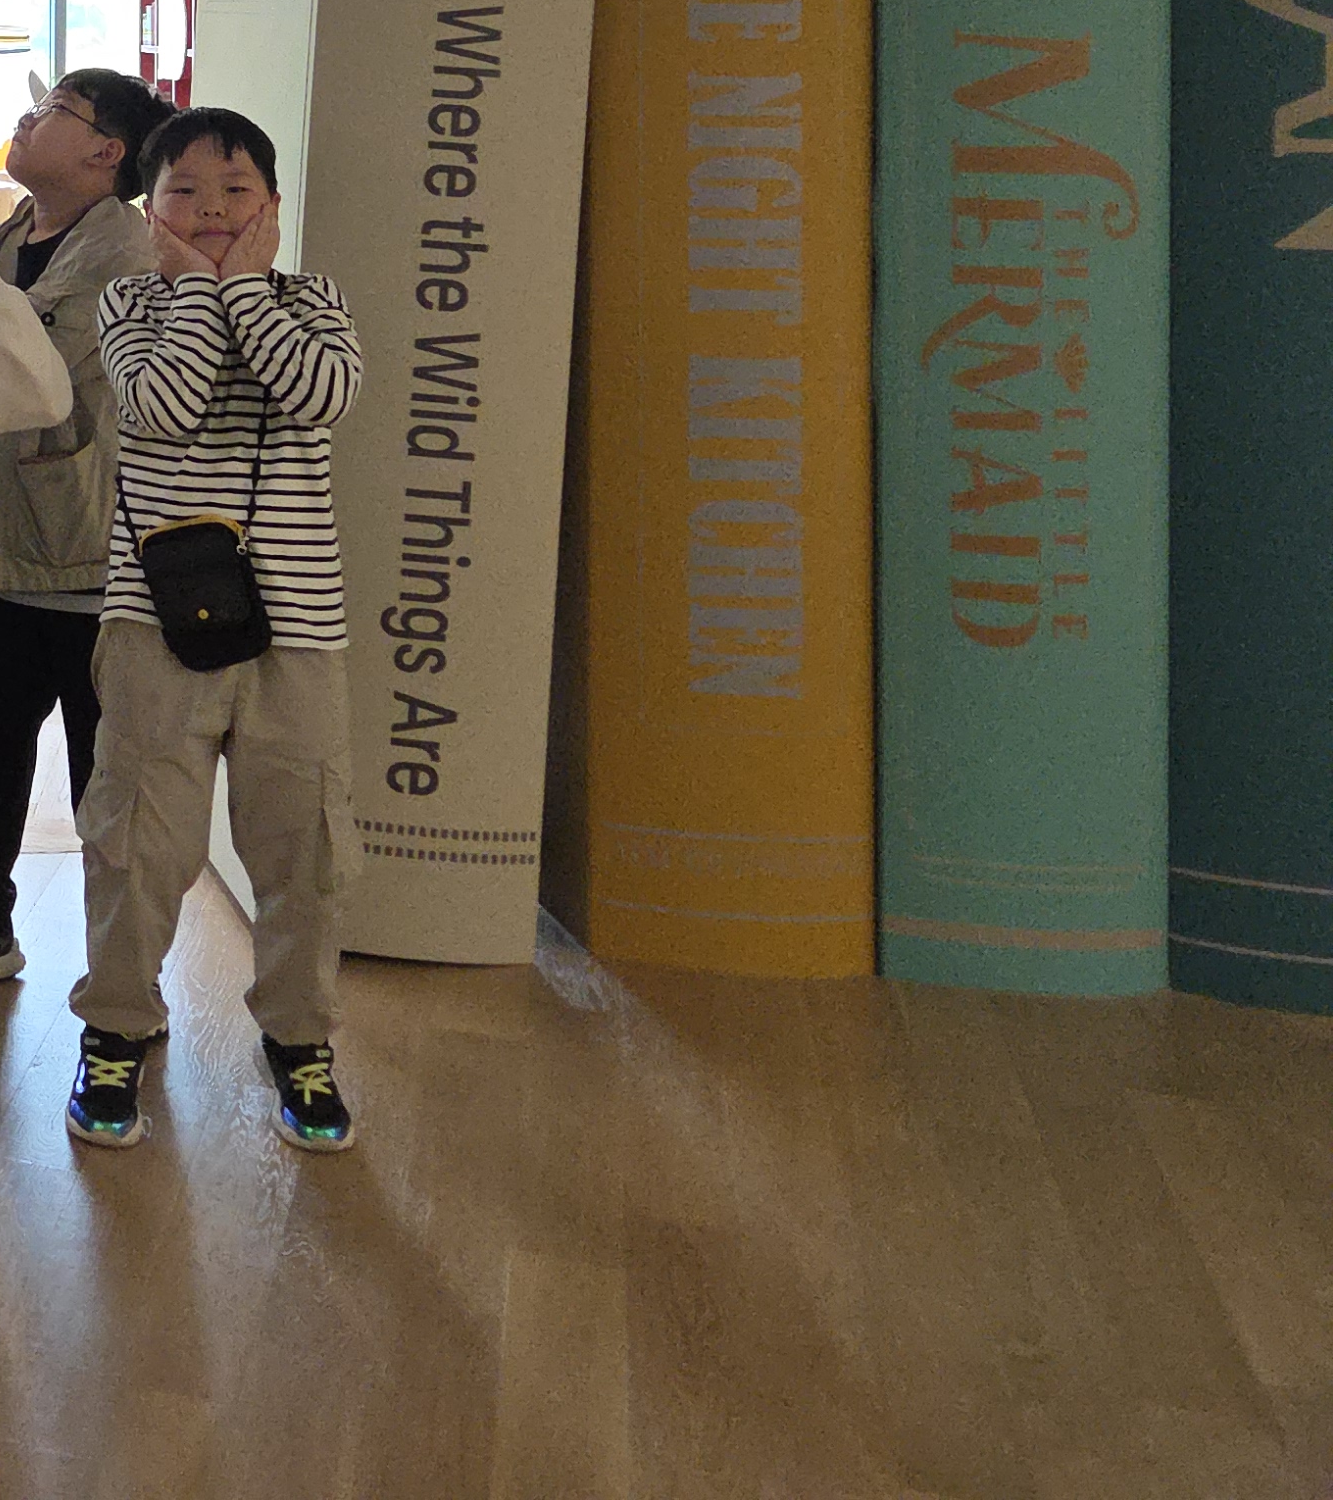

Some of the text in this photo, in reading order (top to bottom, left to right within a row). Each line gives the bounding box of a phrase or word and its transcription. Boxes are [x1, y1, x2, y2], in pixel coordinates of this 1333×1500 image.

[381, 6, 504, 796] Where the Wild Things Are
[687, 72, 803, 324] NIGHT
[920, 30, 1139, 650] MERMAID
[687, 355, 803, 700] KITCHEN
[1050, 202, 1091, 642] THE LITTLE
